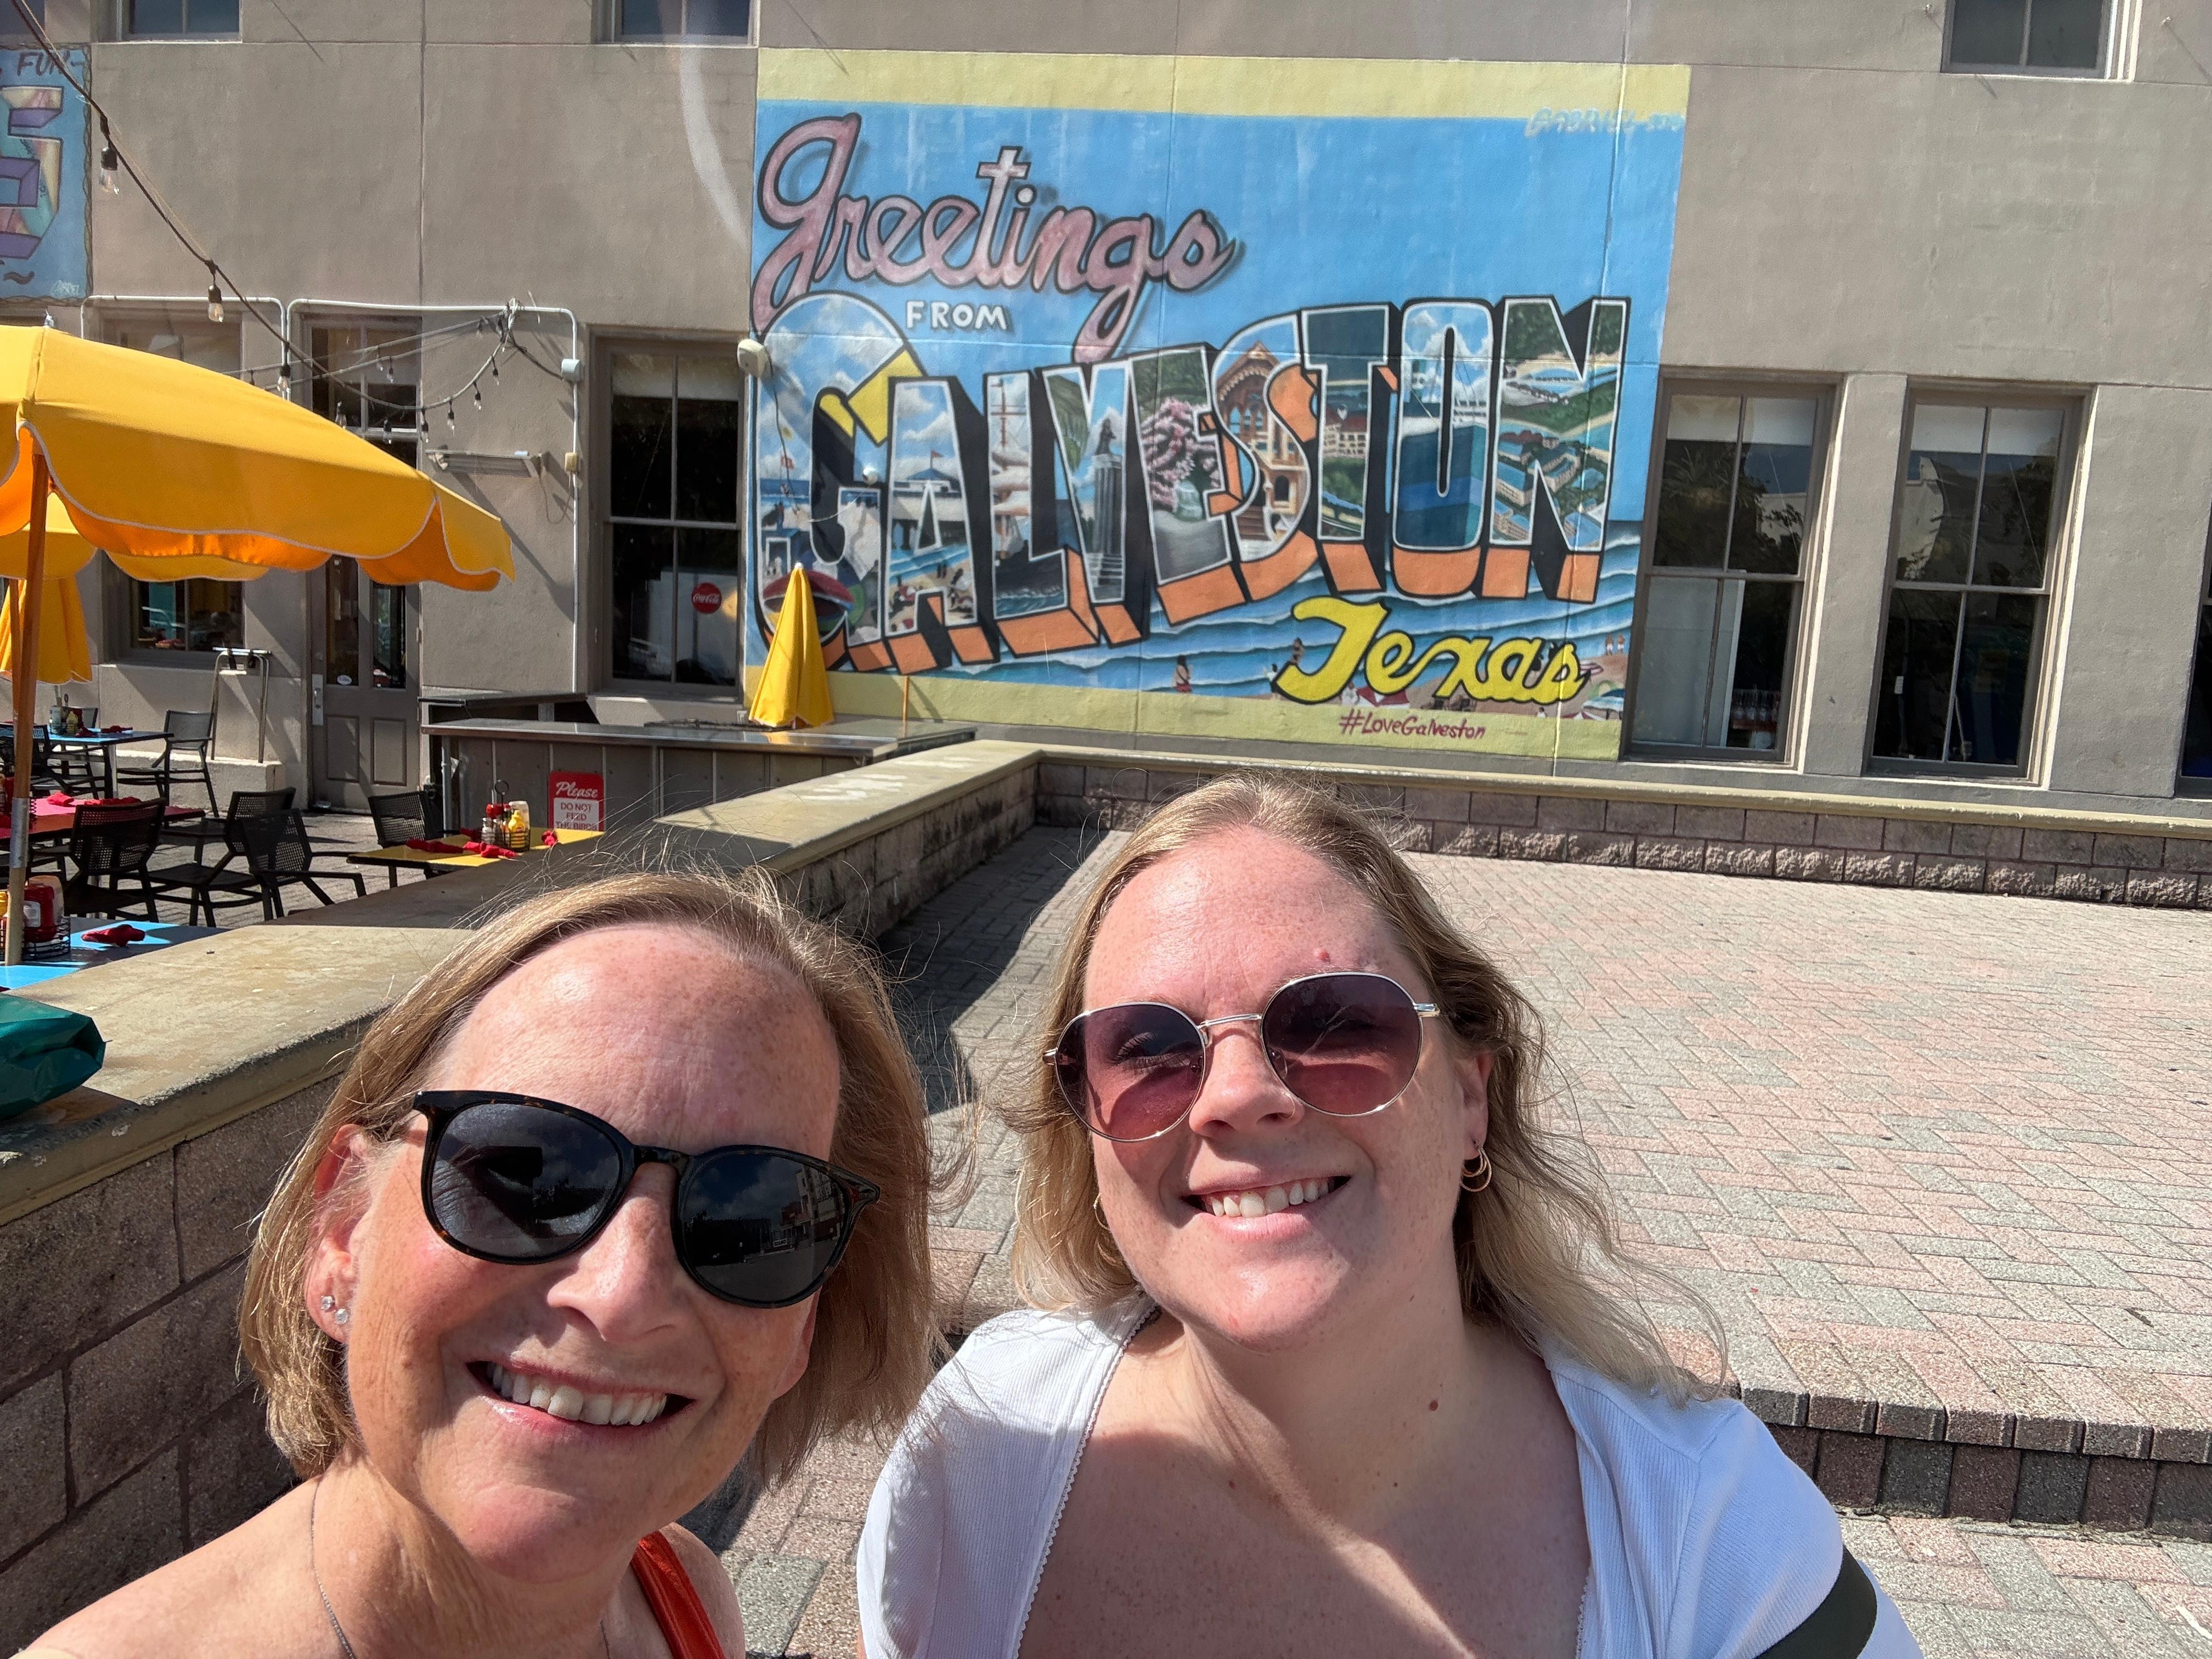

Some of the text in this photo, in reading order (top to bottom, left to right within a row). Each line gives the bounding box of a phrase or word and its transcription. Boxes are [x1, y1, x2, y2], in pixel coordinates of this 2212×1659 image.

[906, 300, 1008, 330] FROM
[752, 290, 1630, 675] GALVESTON
[1273, 595, 1590, 705] Texas
[1339, 708, 1486, 740] #LoveGalveston
[556, 781, 598, 798] Please
[561, 803, 591, 812] DO NOT
[566, 812, 587, 821] FEED
